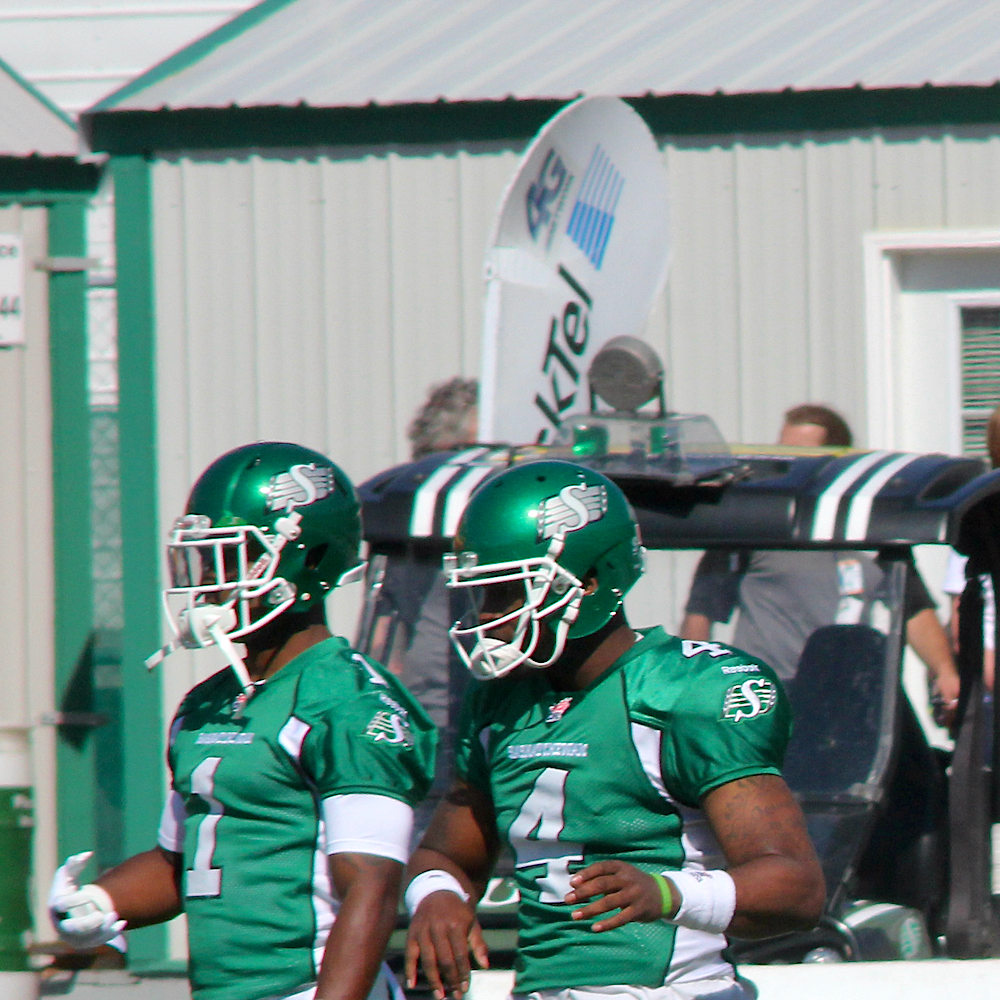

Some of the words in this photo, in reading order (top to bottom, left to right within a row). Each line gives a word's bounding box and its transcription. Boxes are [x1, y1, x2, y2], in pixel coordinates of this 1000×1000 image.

[534, 262, 593, 444] kTel
[186, 756, 225, 897] 1
[508, 767, 584, 904] 4
